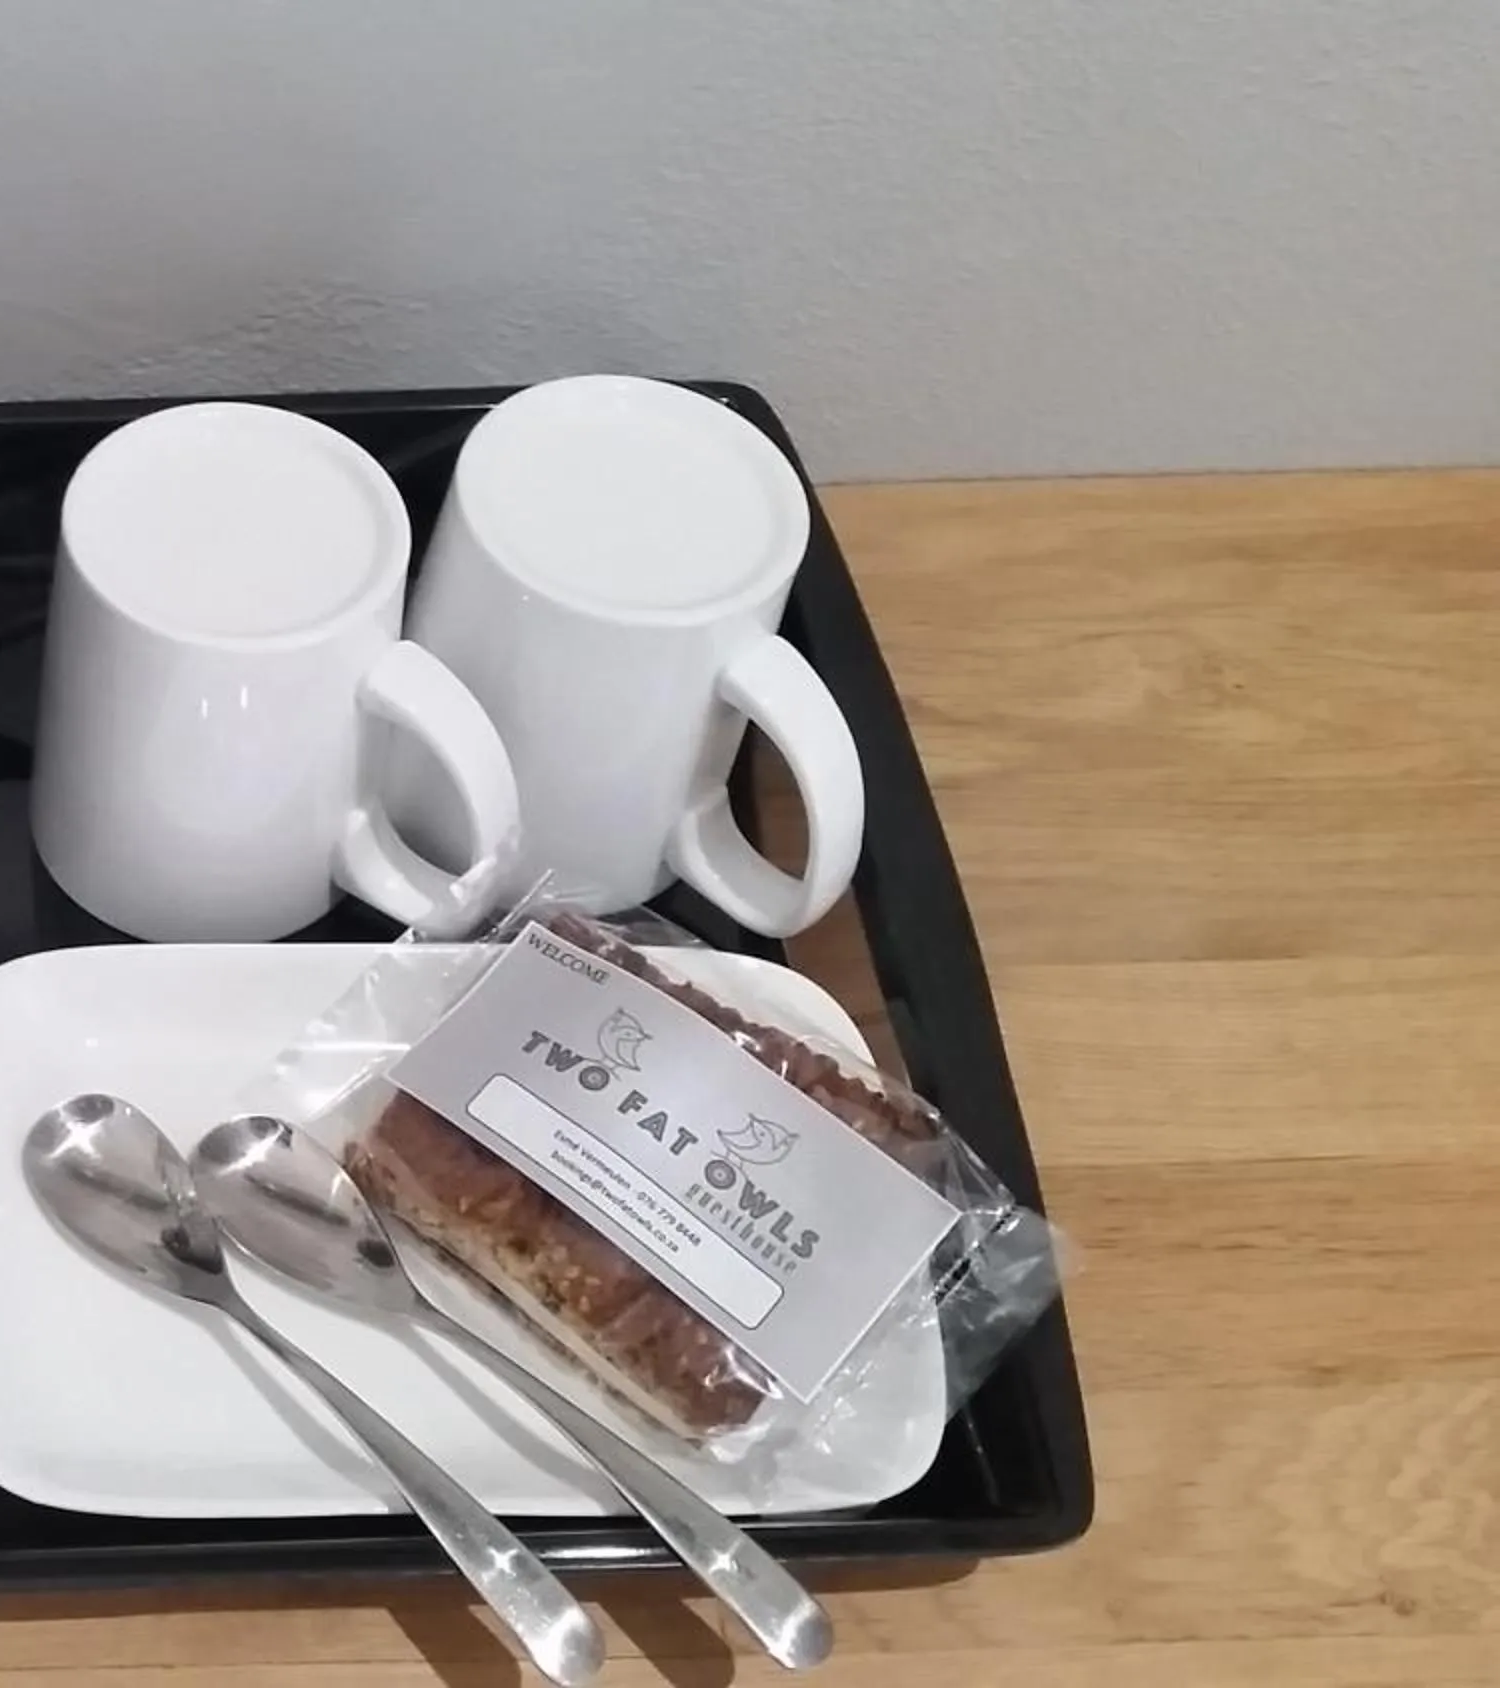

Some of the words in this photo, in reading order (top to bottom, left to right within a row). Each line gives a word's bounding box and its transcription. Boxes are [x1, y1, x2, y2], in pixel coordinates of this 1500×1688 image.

[527, 932, 611, 986] WELCOME
[521, 1029, 611, 1091] TWO
[617, 1089, 700, 1156] FAT
[704, 1159, 820, 1260] OWLS
[685, 1183, 798, 1276] guesthouse
